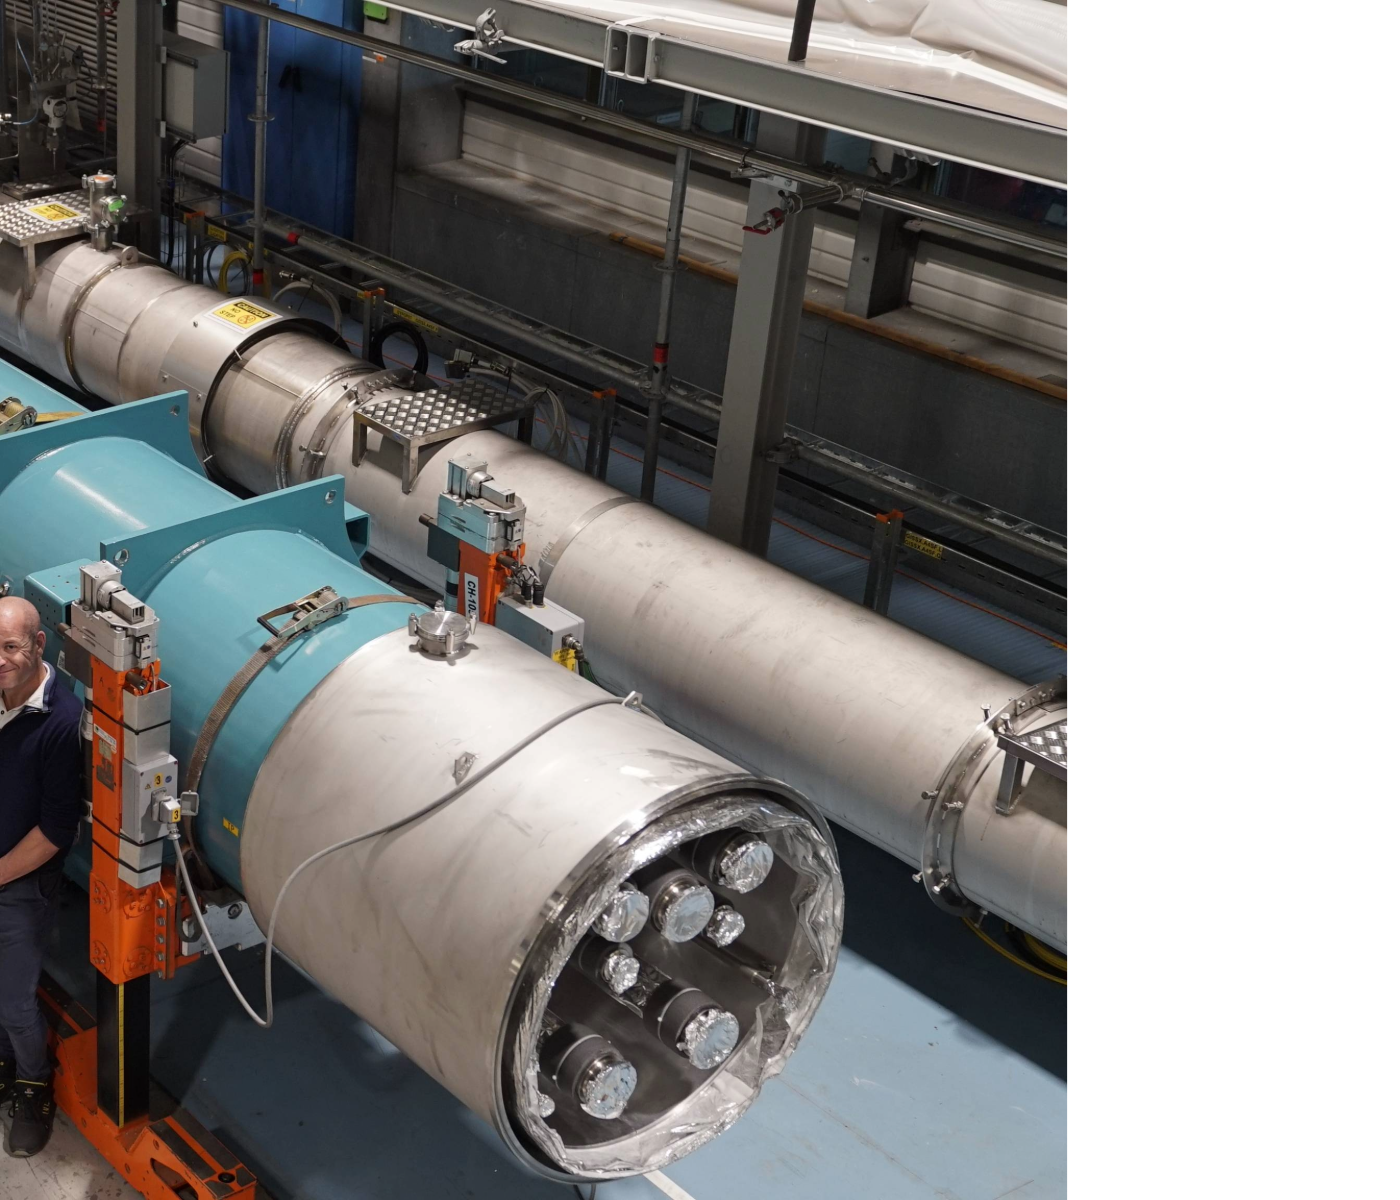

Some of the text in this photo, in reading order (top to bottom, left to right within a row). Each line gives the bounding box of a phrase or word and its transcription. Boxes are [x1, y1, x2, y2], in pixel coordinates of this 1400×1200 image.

[220, 310, 236, 319] STEP
[156, 775, 161, 785] 3
[174, 810, 179, 820] 3
